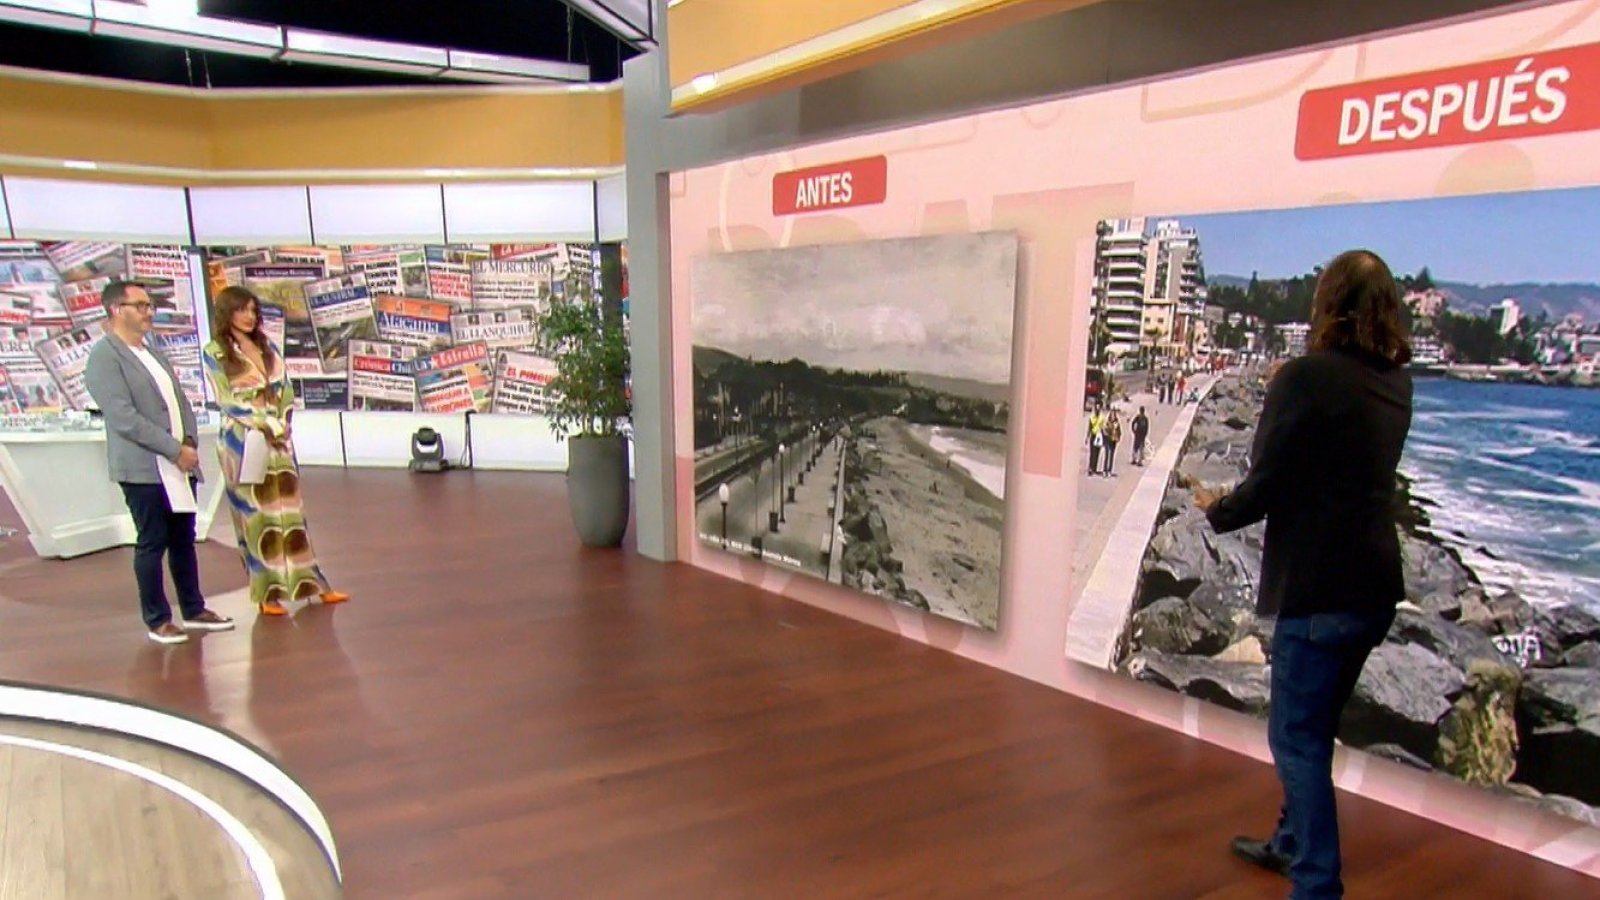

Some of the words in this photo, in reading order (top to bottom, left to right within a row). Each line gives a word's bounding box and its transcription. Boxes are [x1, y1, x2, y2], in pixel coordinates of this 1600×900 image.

[1338, 58, 1570, 145] DESPUÉS
[795, 172, 852, 208] ANTES
[472, 261, 487, 274] EL
[489, 259, 551, 274] MERCURIO
[377, 311, 440, 332] Atacama
[436, 344, 485, 367] Estrella
